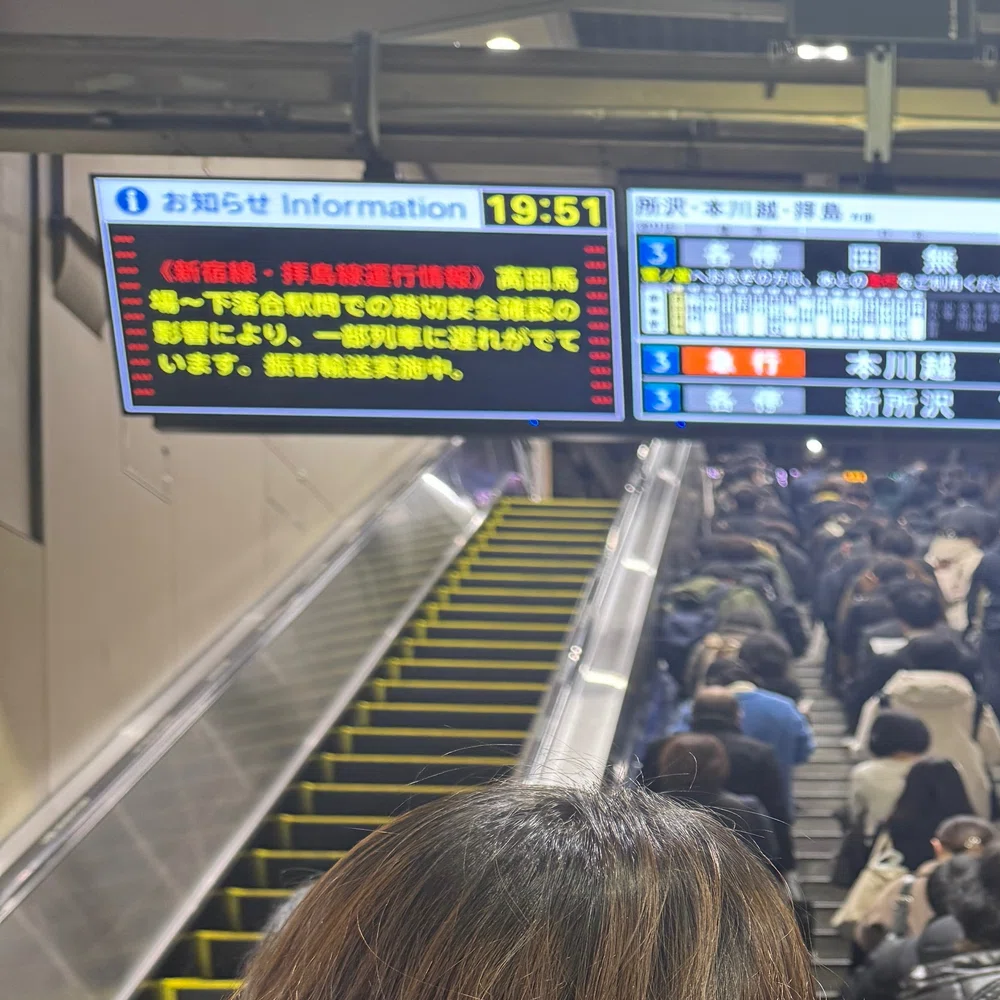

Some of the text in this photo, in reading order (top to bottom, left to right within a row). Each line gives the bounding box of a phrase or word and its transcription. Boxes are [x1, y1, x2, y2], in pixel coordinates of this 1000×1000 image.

[162, 191, 467, 219] お知らせ Information
[487, 194, 601, 227] 19:51
[647, 241, 668, 266] 3
[651, 350, 672, 374] 3
[845, 349, 957, 382] 本川越
[653, 389, 673, 411] 3
[845, 387, 956, 420] 新所沢
